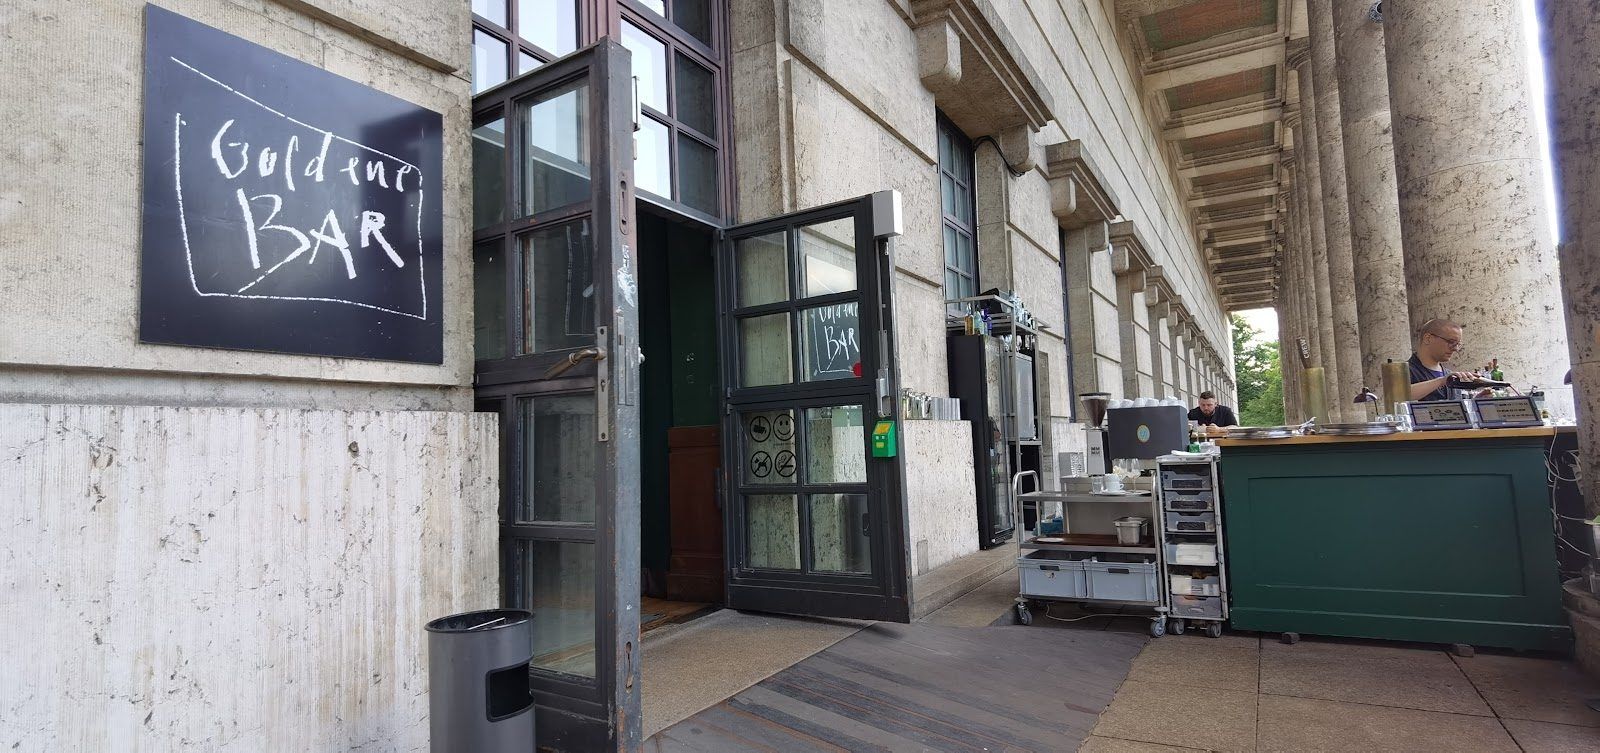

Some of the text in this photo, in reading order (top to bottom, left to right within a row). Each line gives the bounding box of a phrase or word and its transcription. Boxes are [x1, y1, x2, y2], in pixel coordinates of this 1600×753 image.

[211, 119, 411, 192] Goldene
[237, 188, 404, 293] BAR
[824, 326, 860, 370] BAR
